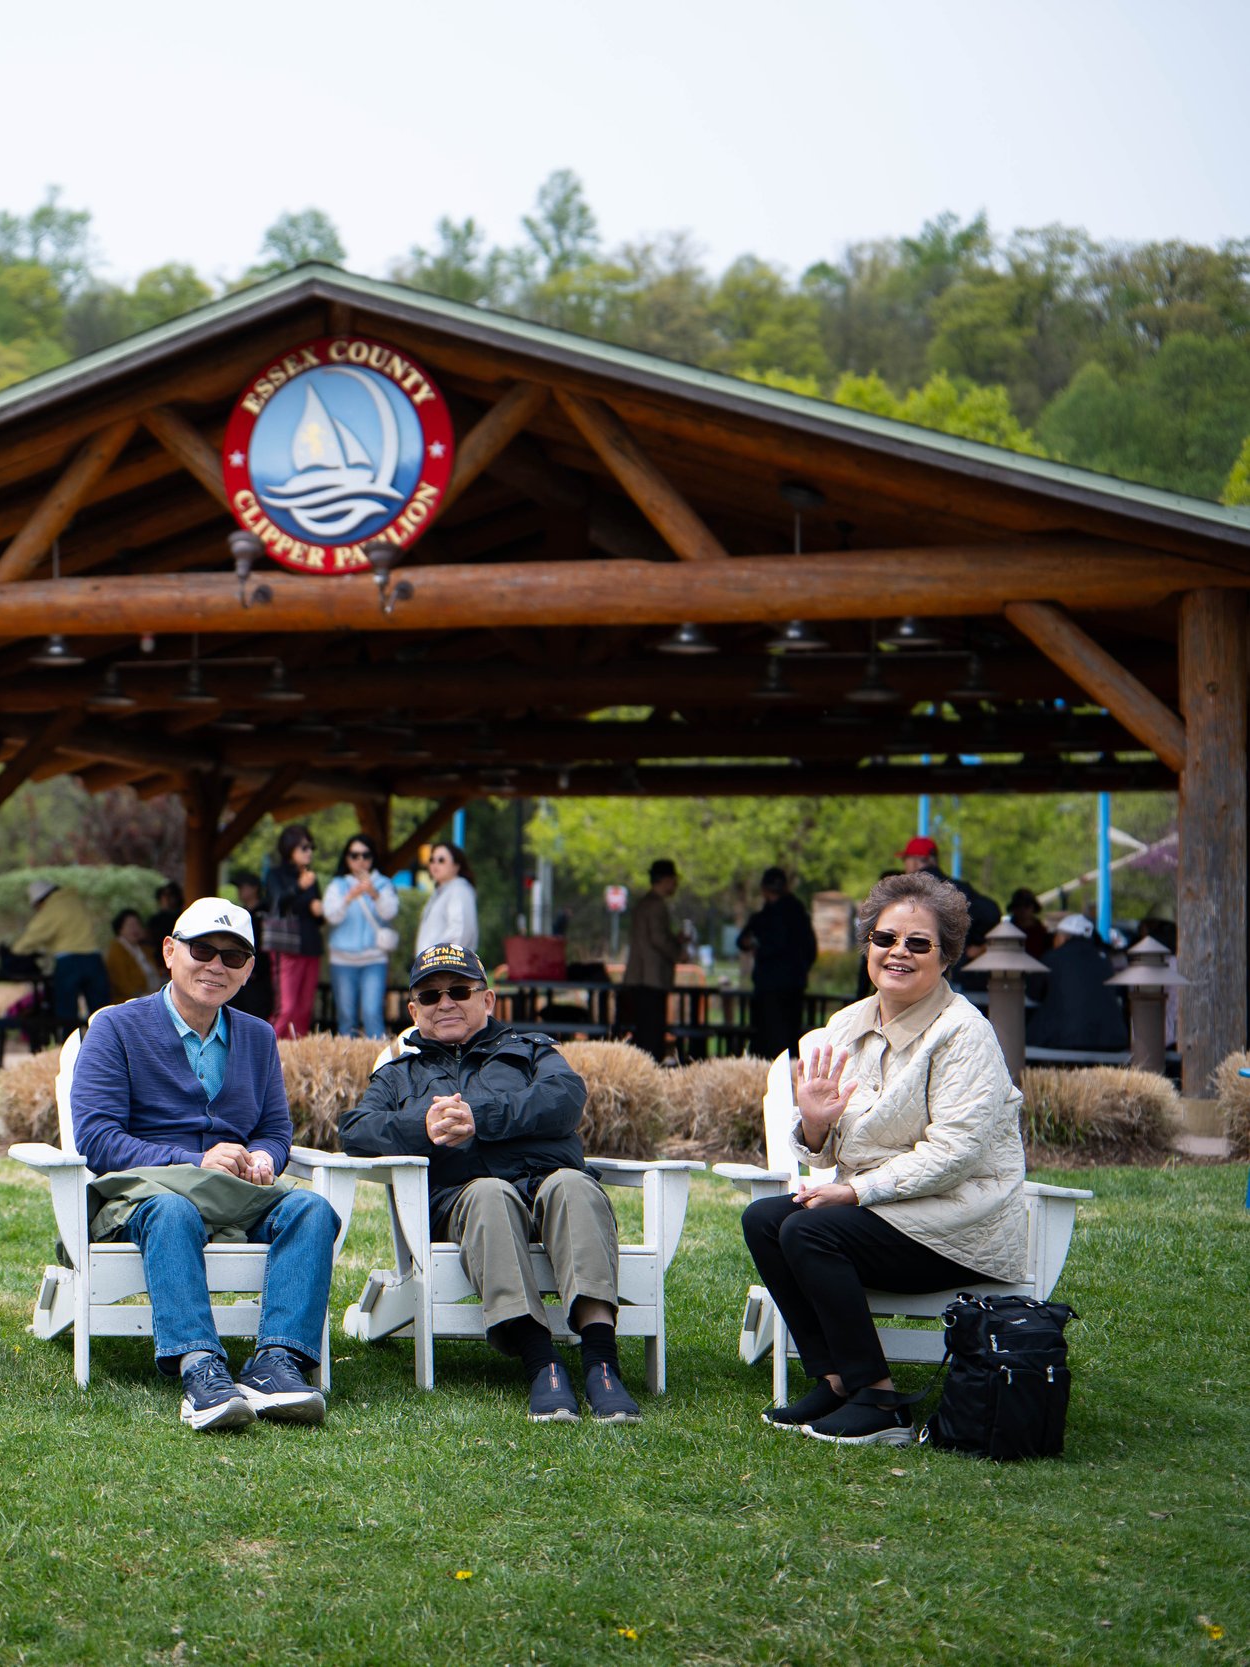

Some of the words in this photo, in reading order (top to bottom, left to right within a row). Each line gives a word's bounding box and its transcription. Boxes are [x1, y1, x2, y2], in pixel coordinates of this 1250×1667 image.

[241, 347, 321, 416] ESSEX
[328, 340, 437, 406] COUNTY
[233, 488, 326, 568] CLIPPER
[334, 482, 440, 568] PALION
[421, 946, 465, 961] VIETNAM
